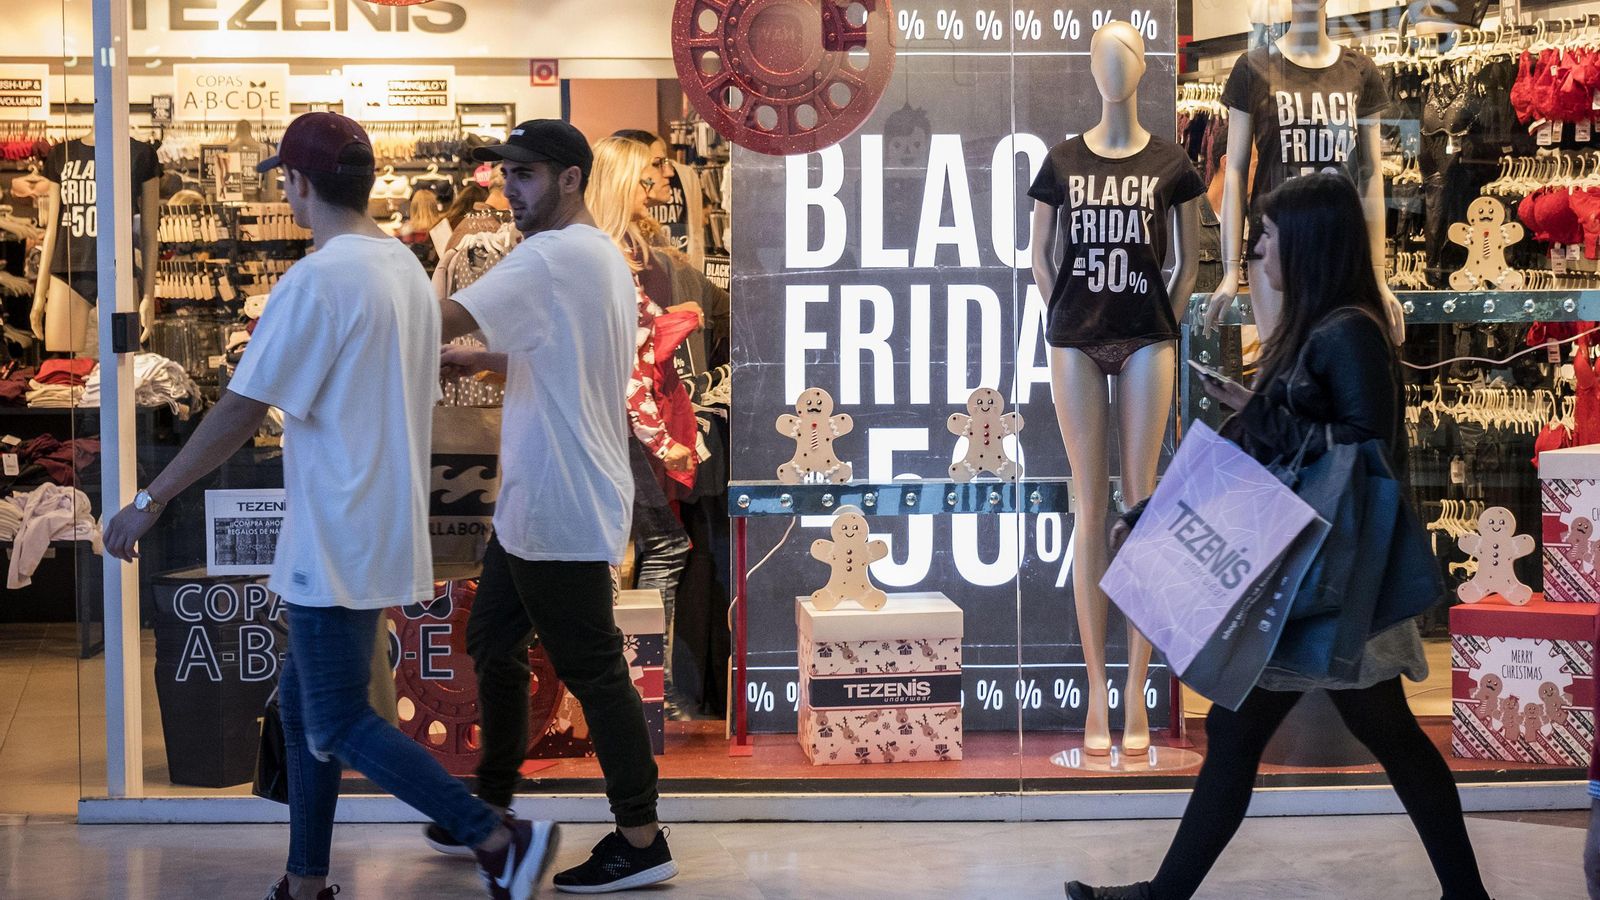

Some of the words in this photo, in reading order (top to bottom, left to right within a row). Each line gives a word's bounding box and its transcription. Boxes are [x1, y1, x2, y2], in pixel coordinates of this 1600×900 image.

[898, 10, 925, 40] %
[937, 10, 964, 40] %
[976, 10, 1002, 40] %
[1015, 10, 1042, 40] %
[1053, 10, 1080, 40] %
[0, 79, 33, 90] USH-UP
[196, 75, 243, 87] COPAS
[0, 96, 41, 106] VOLUMEN
[1276, 91, 1358, 129] BLACK
[1279, 128, 1357, 163] FRIDAY
[60, 160, 95, 180] BLA
[61, 180, 97, 205] FRID
[784, 132, 1078, 270] BLAC
[1068, 175, 1160, 210] BLACK
[648, 204, 684, 224] IDAY
[1070, 208, 1154, 244] FRIDAY
[706, 263, 730, 278] BLACK
[784, 284, 1057, 405] FRIDA
[237, 499, 286, 512] TEZENI
[265, 519, 283, 527] AHO
[430, 522, 487, 536] LLABO
[173, 583, 289, 622] COP
[1511, 649, 1533, 664] MERRY
[1501, 664, 1543, 681] CHRISTMAS
[747, 681, 774, 712] %
[976, 679, 1003, 710] %
[1015, 679, 1042, 710] %
[1053, 678, 1081, 709] %
[843, 679, 931, 698] TEZENIS
